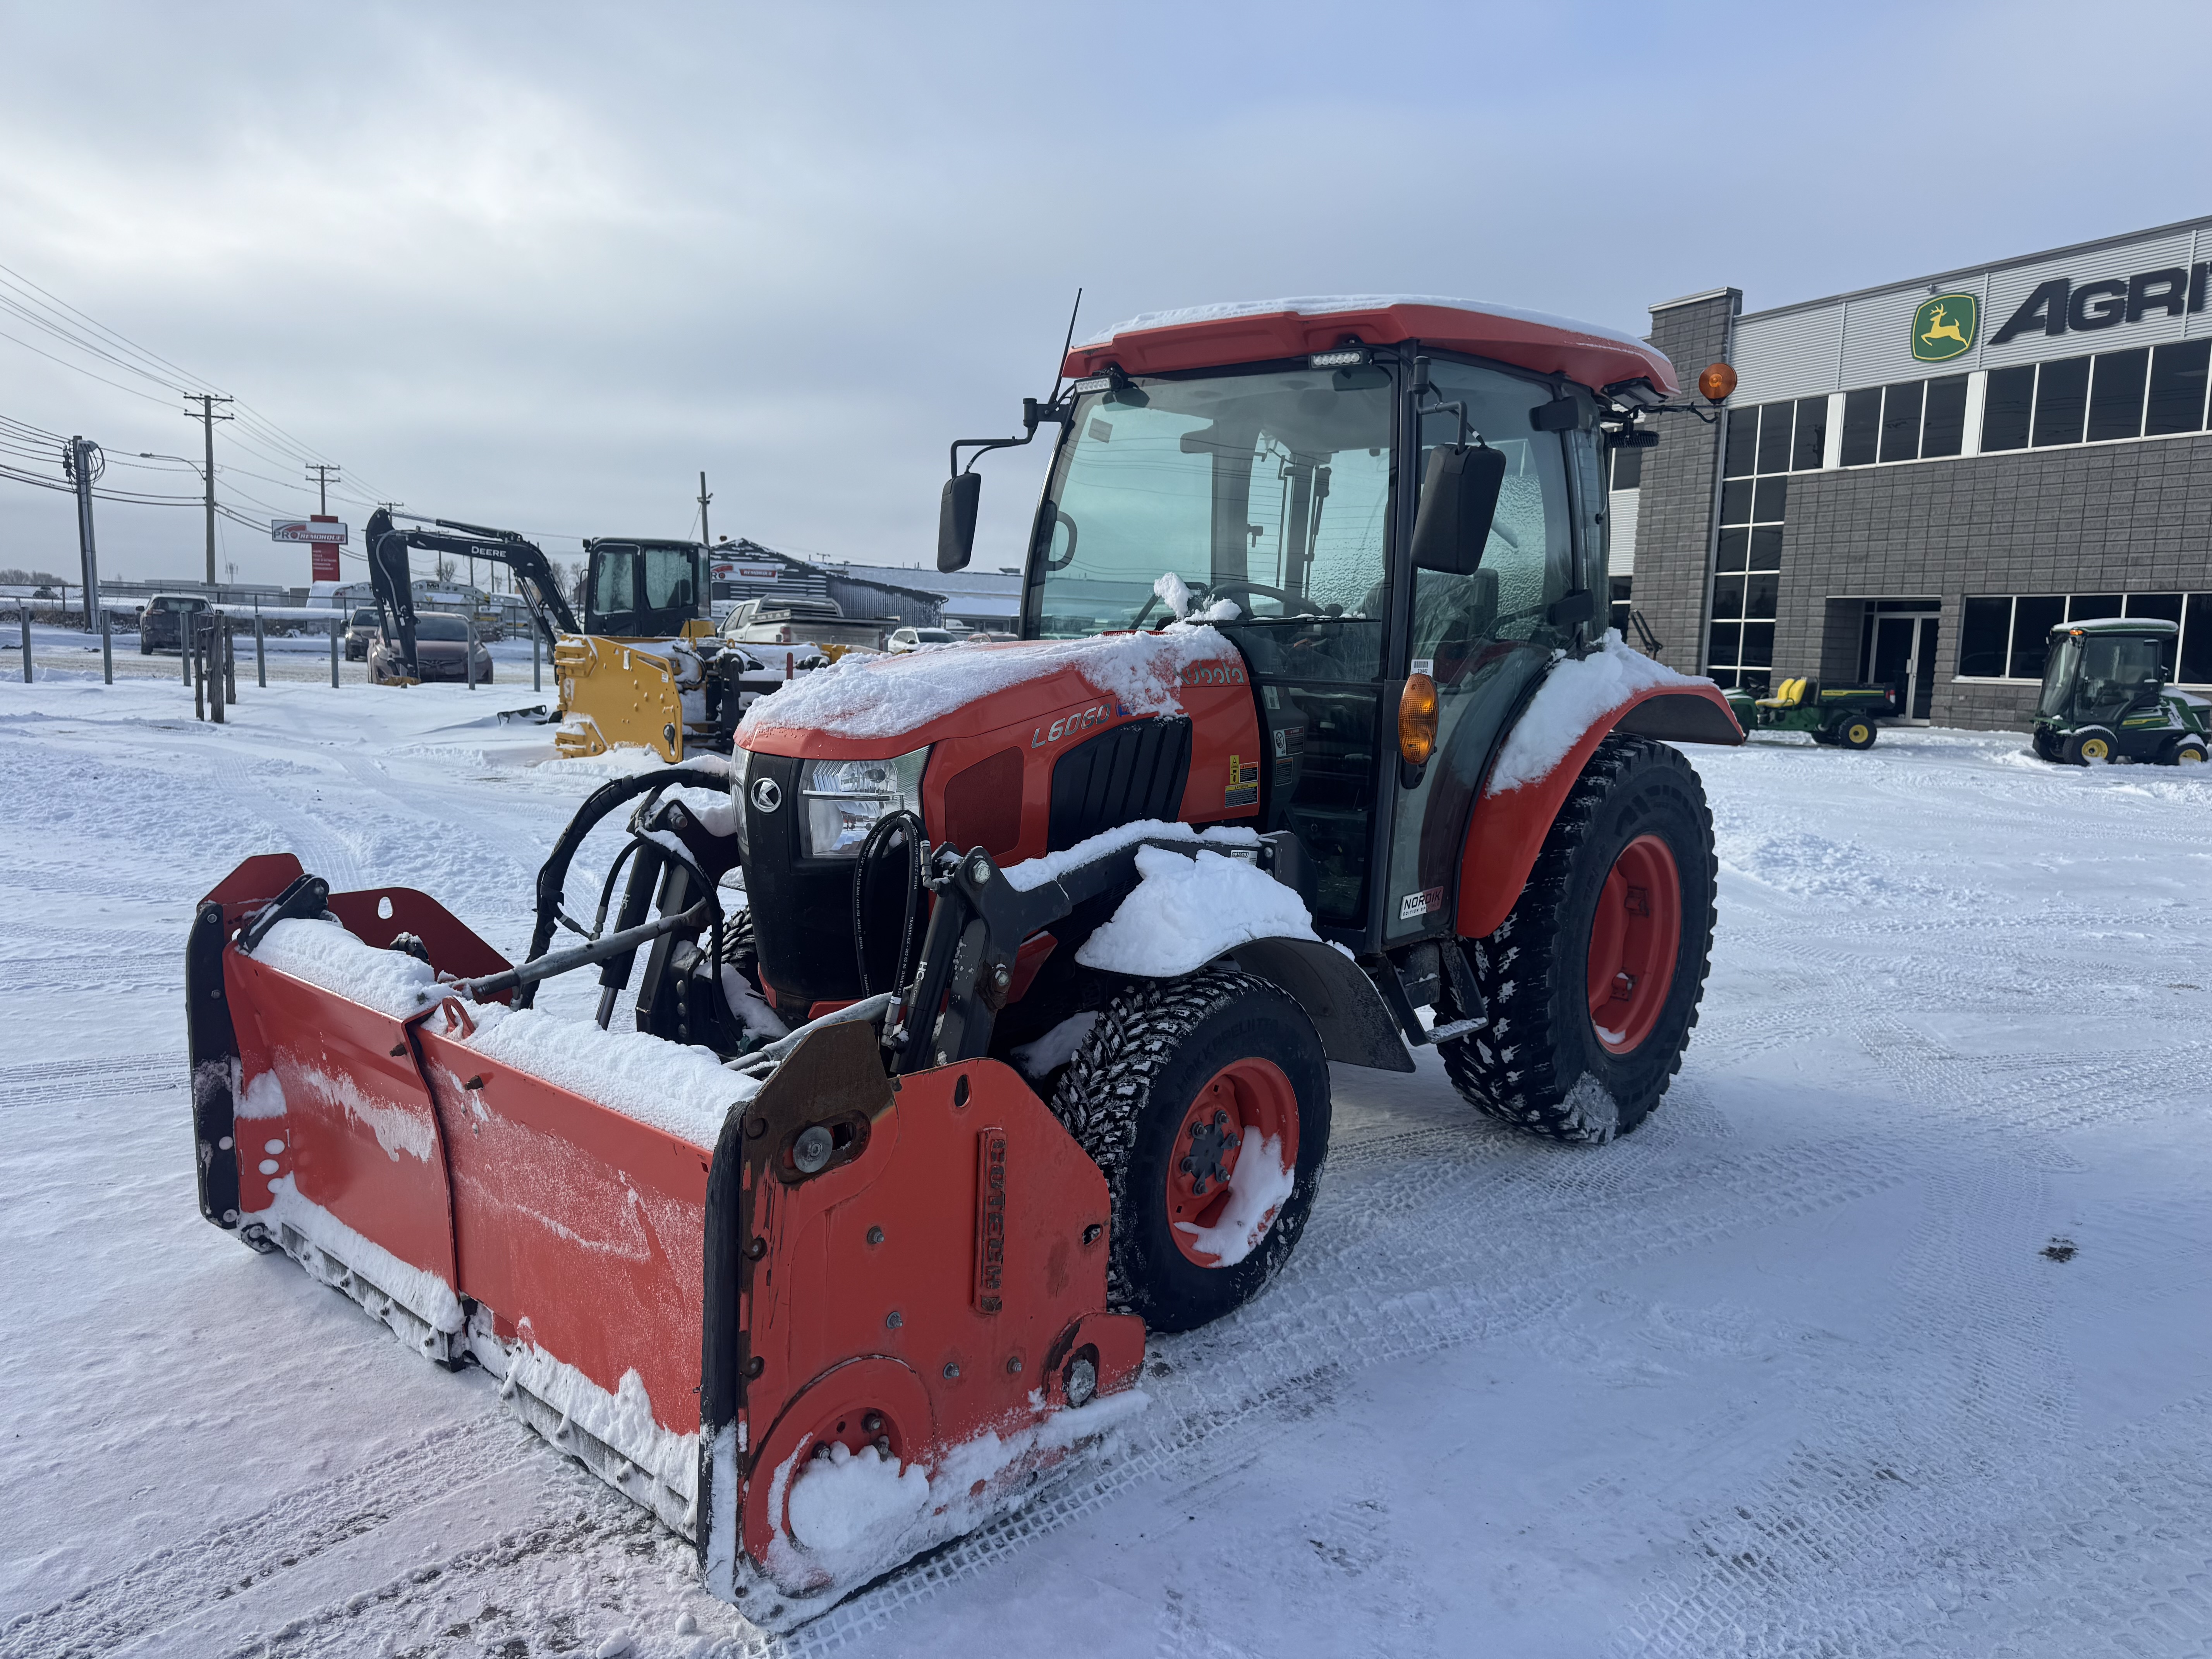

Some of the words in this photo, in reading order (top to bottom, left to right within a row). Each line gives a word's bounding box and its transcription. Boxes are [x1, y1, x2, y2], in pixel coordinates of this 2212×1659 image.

[1988, 262, 2212, 345] AGRI
[274, 530, 298, 539] PRO
[471, 546, 506, 558] DEERE
[1031, 703, 1111, 749] L6060
[621, 894, 630, 910] HC
[1404, 890, 1441, 910] NORDIK
[916, 961, 927, 981] HC
[986, 1139, 1006, 1290] COTECH
